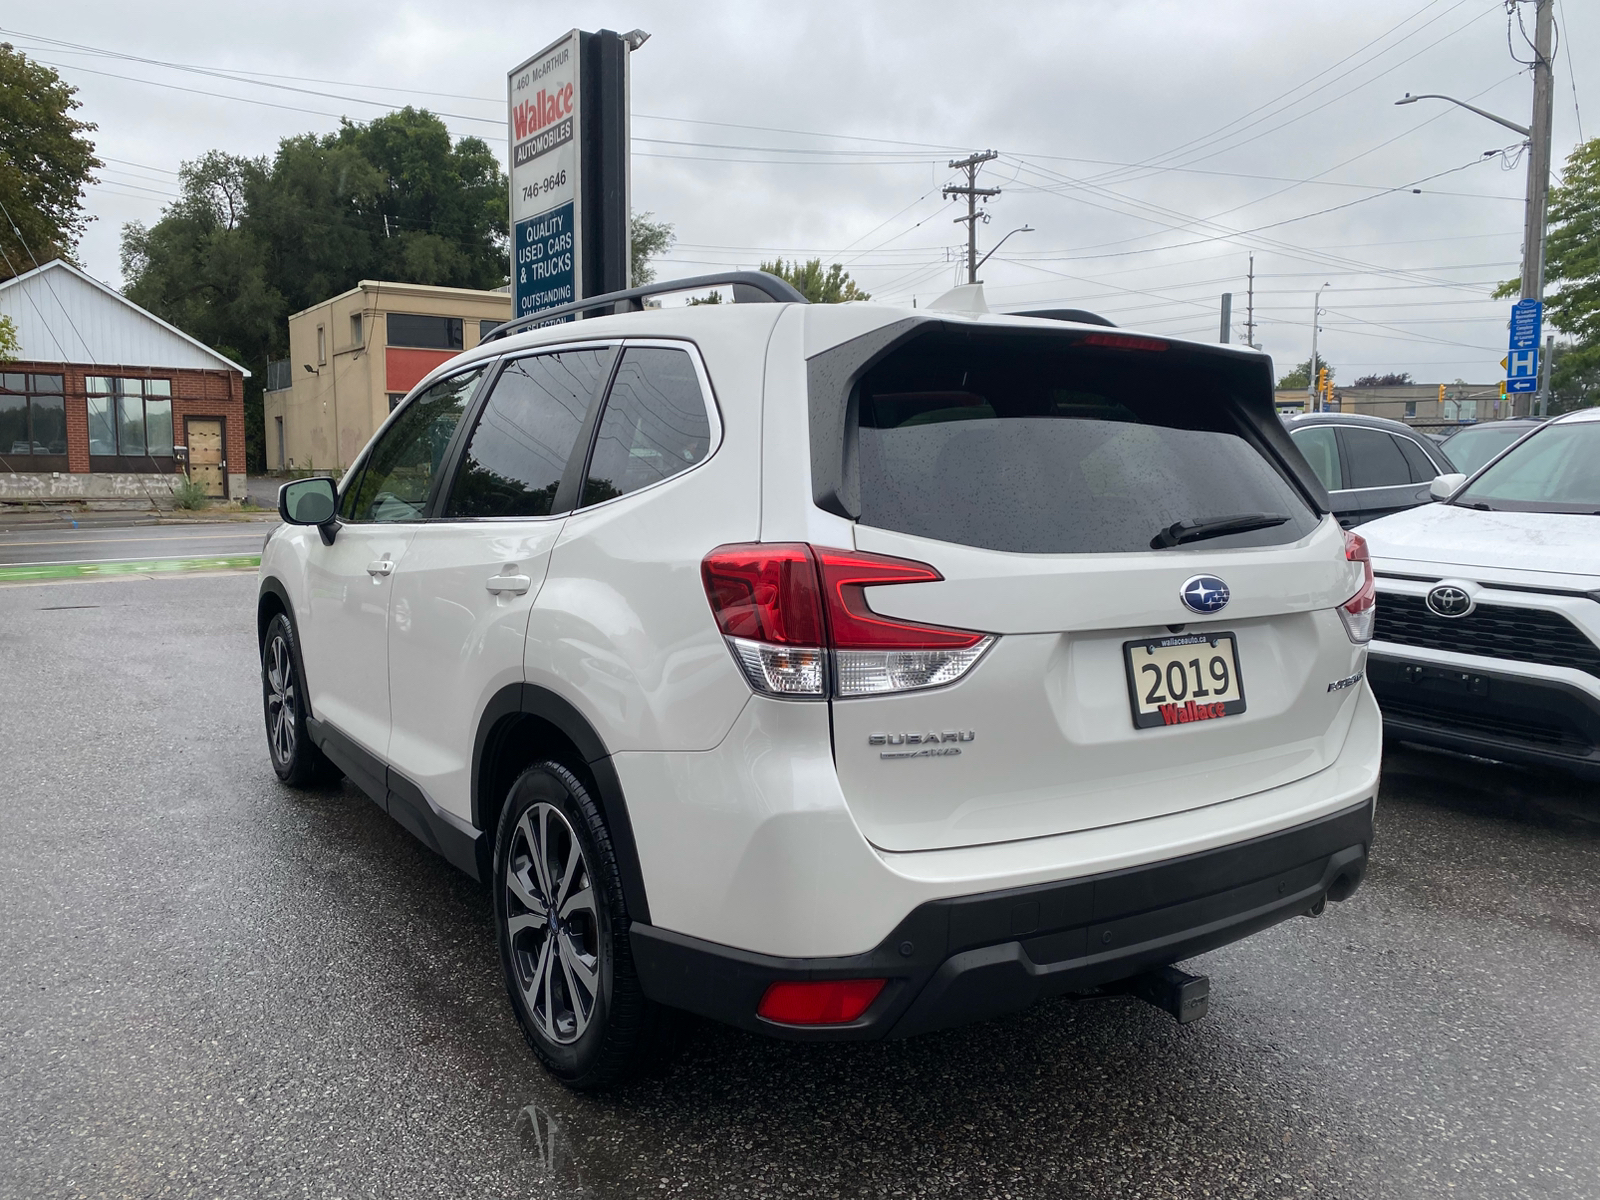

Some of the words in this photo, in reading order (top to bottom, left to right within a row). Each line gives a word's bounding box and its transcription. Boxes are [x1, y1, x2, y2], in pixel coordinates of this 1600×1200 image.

[516, 73, 530, 91] 460
[532, 48, 569, 82] McARTHUR
[512, 81, 574, 141] Wallace
[517, 121, 571, 162] AUTOMOBILES
[522, 169, 567, 202] 746-9646
[526, 214, 564, 243] QUALITY
[519, 243, 544, 264] USED
[547, 231, 572, 255] CARS
[520, 267, 527, 284] &
[532, 252, 572, 281] TRUCKS
[521, 284, 571, 309] OUTSTANDING
[1511, 351, 1534, 377] H
[1161, 636, 1207, 647] wallaceauto.ca
[1141, 655, 1230, 704] 2019
[1327, 670, 1365, 693] FOREST
[1158, 700, 1227, 725] Wallace
[868, 730, 975, 745] SUBARU
[911, 747, 962, 758] AWD
